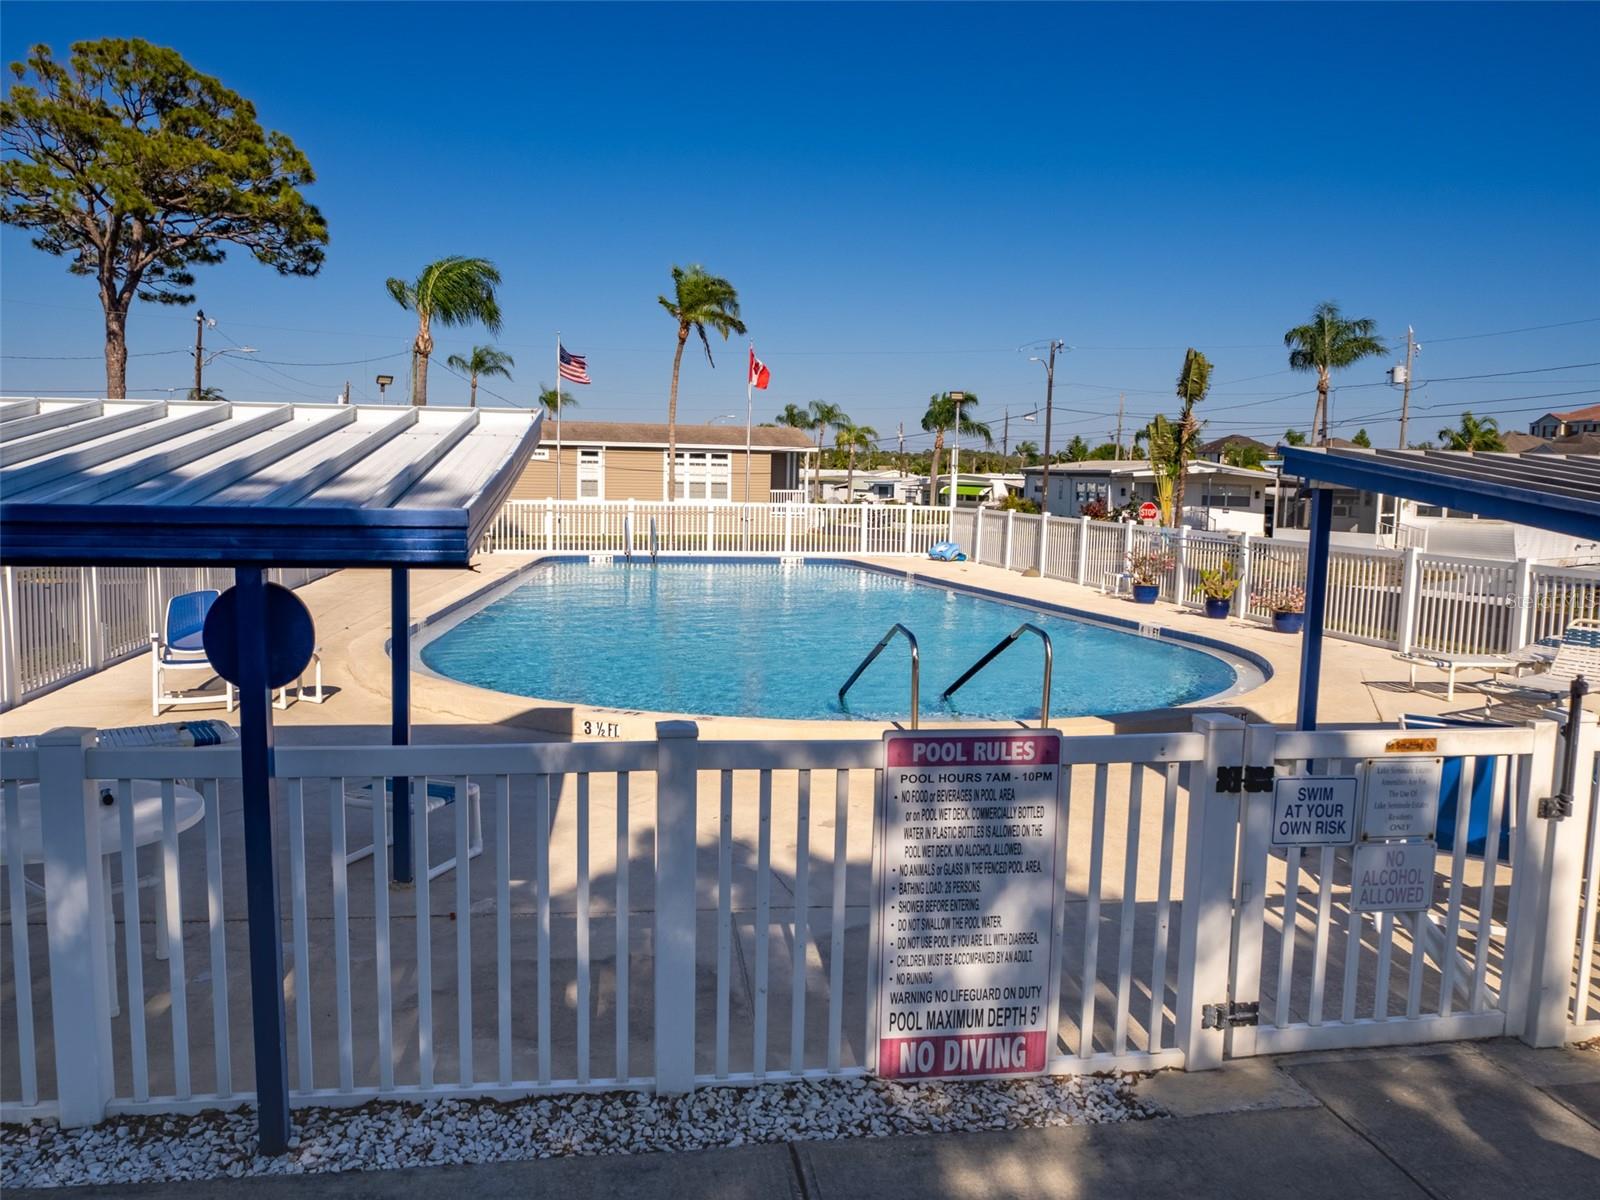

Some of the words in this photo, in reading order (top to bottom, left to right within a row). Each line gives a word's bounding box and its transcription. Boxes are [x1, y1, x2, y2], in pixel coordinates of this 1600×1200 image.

[1141, 508, 1156, 517] STOP
[584, 721, 592, 735] 3
[913, 742, 967, 762] POOL
[974, 740, 1036, 761] RULES
[900, 774, 934, 784] POOL
[939, 773, 982, 784] HOURS
[985, 772, 1011, 783] 7AM
[1023, 771, 1053, 782] 10PM
[901, 790, 910, 803] NO
[911, 790, 929, 803] FOOD
[929, 792, 936, 803] or
[937, 789, 972, 802] BEVERAGES
[974, 789, 980, 801] IN
[980, 788, 997, 801] POOL
[999, 788, 1016, 801] AREA
[1297, 787, 1334, 802] SWIM
[905, 811, 912, 821] or
[913, 811, 920, 821] on
[921, 808, 938, 821] POOL
[939, 808, 952, 821] WET
[971, 806, 1017, 820] COMMERCIALLY
[1018, 805, 1044, 819] BOTTLED
[1284, 804, 1304, 818] AT
[1306, 804, 1344, 818] YOUR
[904, 827, 924, 839] WATER
[925, 826, 932, 839] IN
[932, 826, 957, 839] PLASTIC
[958, 825, 984, 838] BOTTLES
[985, 825, 991, 838] IS
[992, 824, 1020, 838] ALLOWED
[1021, 824, 1030, 837] ON
[1031, 823, 1043, 837] THE
[1279, 821, 1312, 836] OWN
[1315, 820, 1347, 835] RISK
[905, 845, 921, 858] POOL
[922, 845, 935, 858] WET
[955, 844, 964, 857] NO
[965, 843, 993, 857] ALCOHOL
[1385, 851, 1405, 867] NO
[899, 864, 908, 877] NO
[909, 863, 935, 876] ANIMALS
[936, 866, 942, 876] or
[943, 862, 963, 876] GLASS
[964, 862, 970, 875] IN
[972, 862, 983, 875] THE
[984, 861, 1007, 875] FENCED
[1008, 861, 1024, 874] POOL
[1361, 868, 1424, 887] ALCOHOL
[899, 882, 925, 895] BATHING
[1359, 887, 1424, 905] ALLOWED
[898, 900, 924, 913] SHOWER
[925, 899, 949, 913] BEFORE
[898, 919, 907, 931] DO
[908, 918, 920, 931] NOT
[921, 917, 951, 931] SWALLOW
[952, 917, 963, 929] THE
[965, 916, 980, 929] POOL
[898, 937, 906, 949] DO
[907, 936, 920, 949] NOT
[920, 935, 933, 948] USE
[934, 935, 950, 948] POOL
[951, 935, 957, 947] IF
[958, 934, 970, 947] YOU
[971, 934, 983, 947] ARE
[984, 933, 992, 946] ILL
[994, 933, 1008, 946] WITH
[897, 954, 926, 967] CHILDREN
[927, 953, 943, 966] MUST
[944, 953, 953, 966] BE
[954, 951, 995, 966] ACCOMPANIED
[996, 951, 1004, 964] BY
[1004, 951, 1013, 963] AN
[896, 972, 905, 985] NO
[906, 971, 933, 985] RUNNING
[890, 991, 932, 1004] WARNING
[935, 990, 948, 1003] NO
[950, 988, 1000, 1002] LIFEGUARD
[1003, 987, 1016, 1000] ON
[1019, 986, 1042, 999] DUTY
[889, 1011, 923, 1032] POOL
[926, 1008, 984, 1030] MAXIMUM
[987, 1006, 1027, 1027] DEPTH
[1030, 1006, 1040, 1025] 5'
[900, 1040, 936, 1074] NO
[943, 1036, 1026, 1072] DIVING
